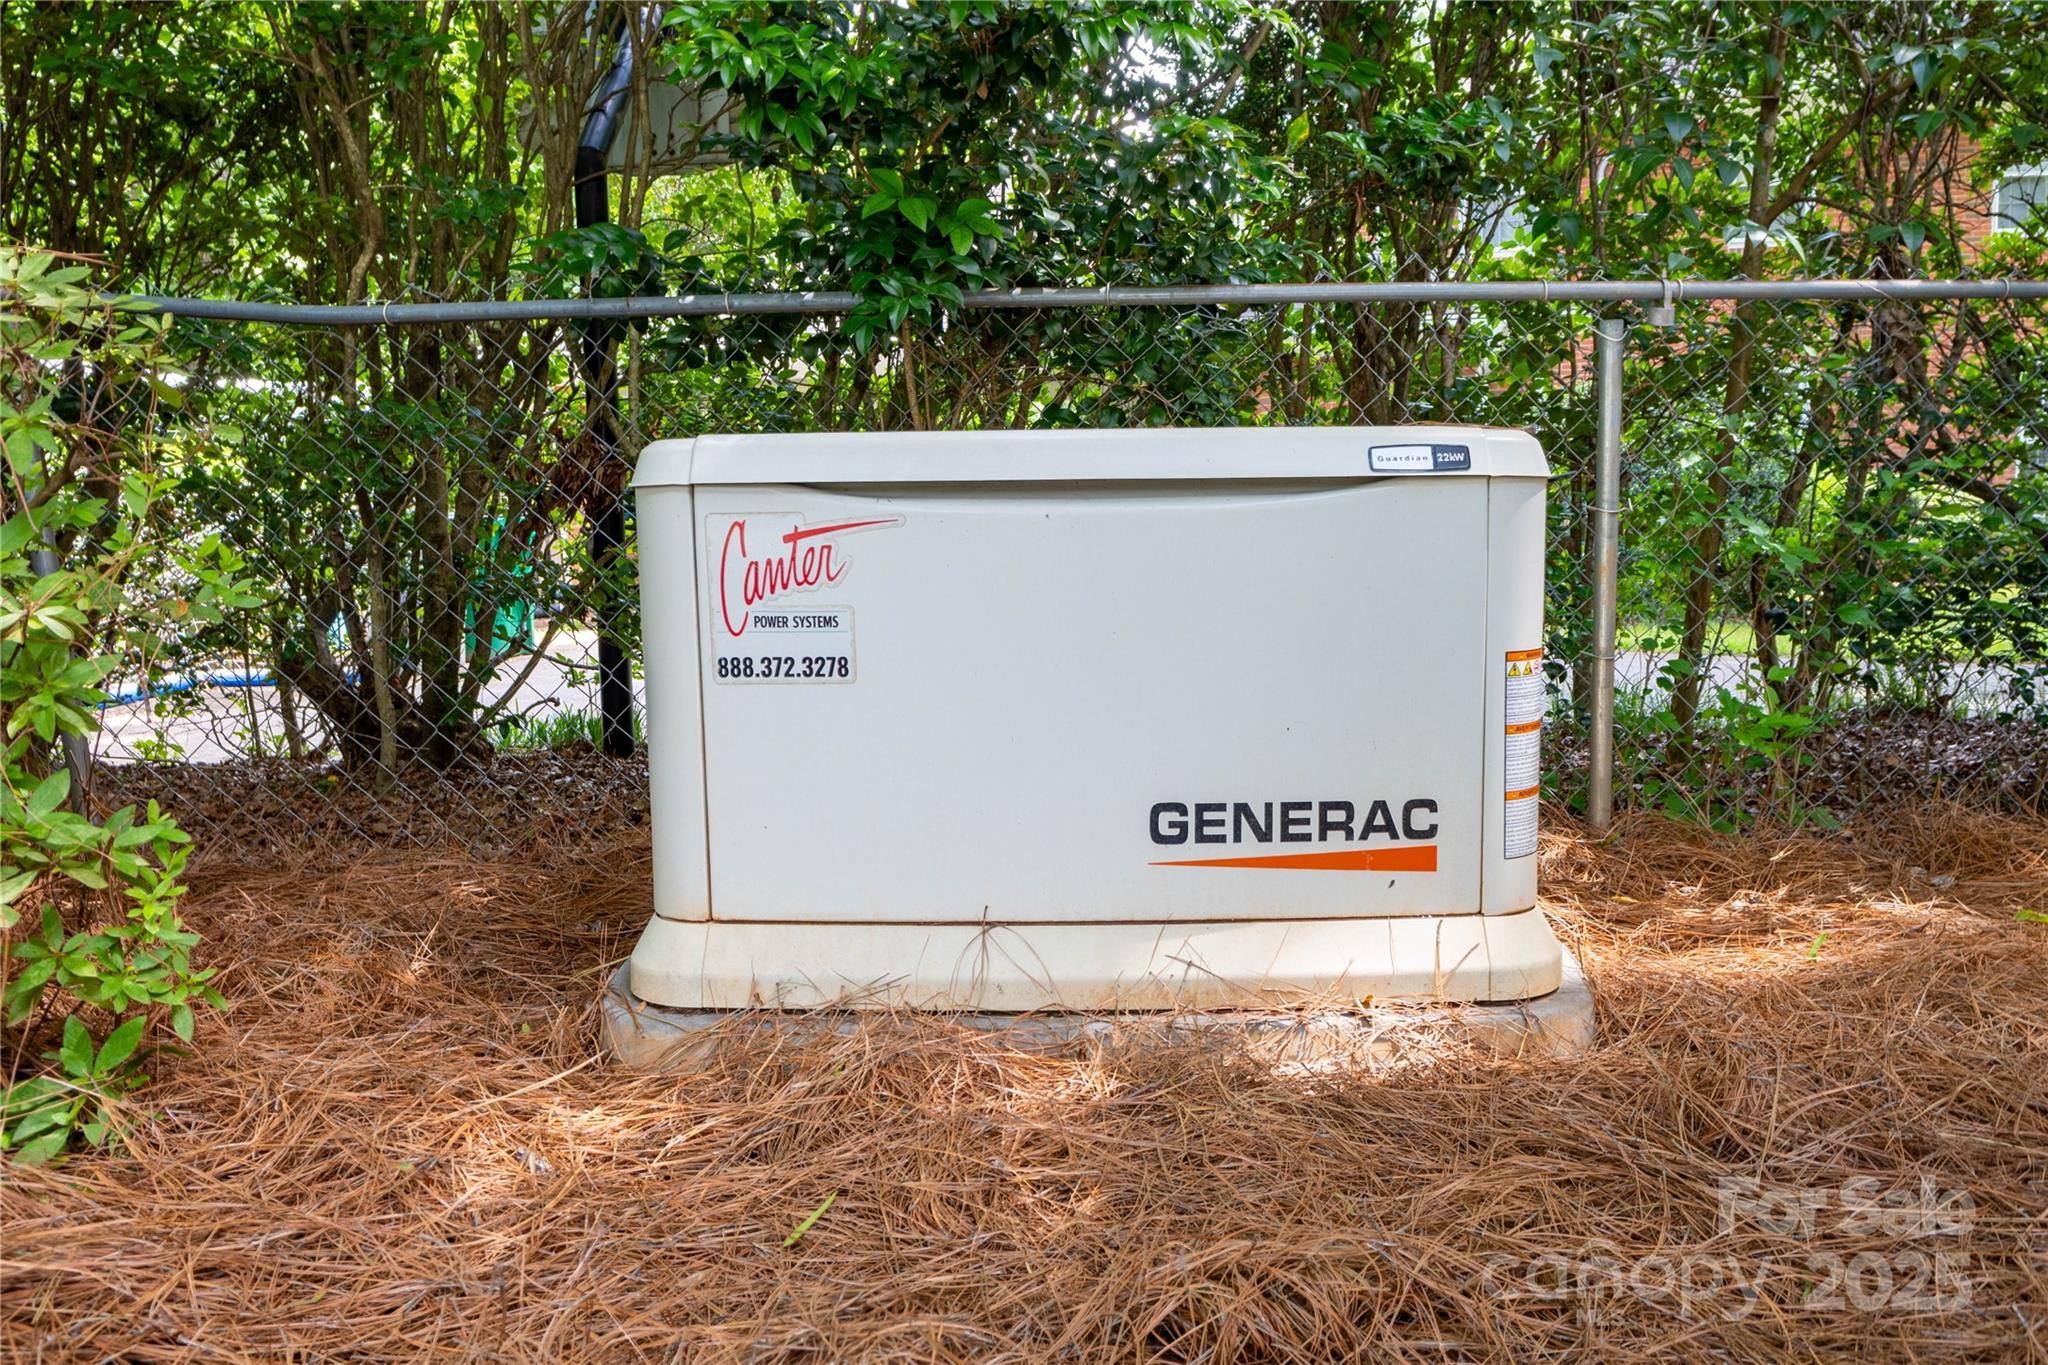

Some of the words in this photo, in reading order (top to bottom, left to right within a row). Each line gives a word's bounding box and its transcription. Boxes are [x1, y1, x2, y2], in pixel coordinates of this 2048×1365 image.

[1376, 454, 1429, 463] Guardian
[1436, 452, 1465, 462] 22kW
[720, 519, 898, 637] Canter
[753, 615, 789, 628] POWER
[792, 615, 839, 628] SYSTEMS
[717, 656, 849, 678] 888.372.3278
[1150, 798, 1438, 845] GENERAC
